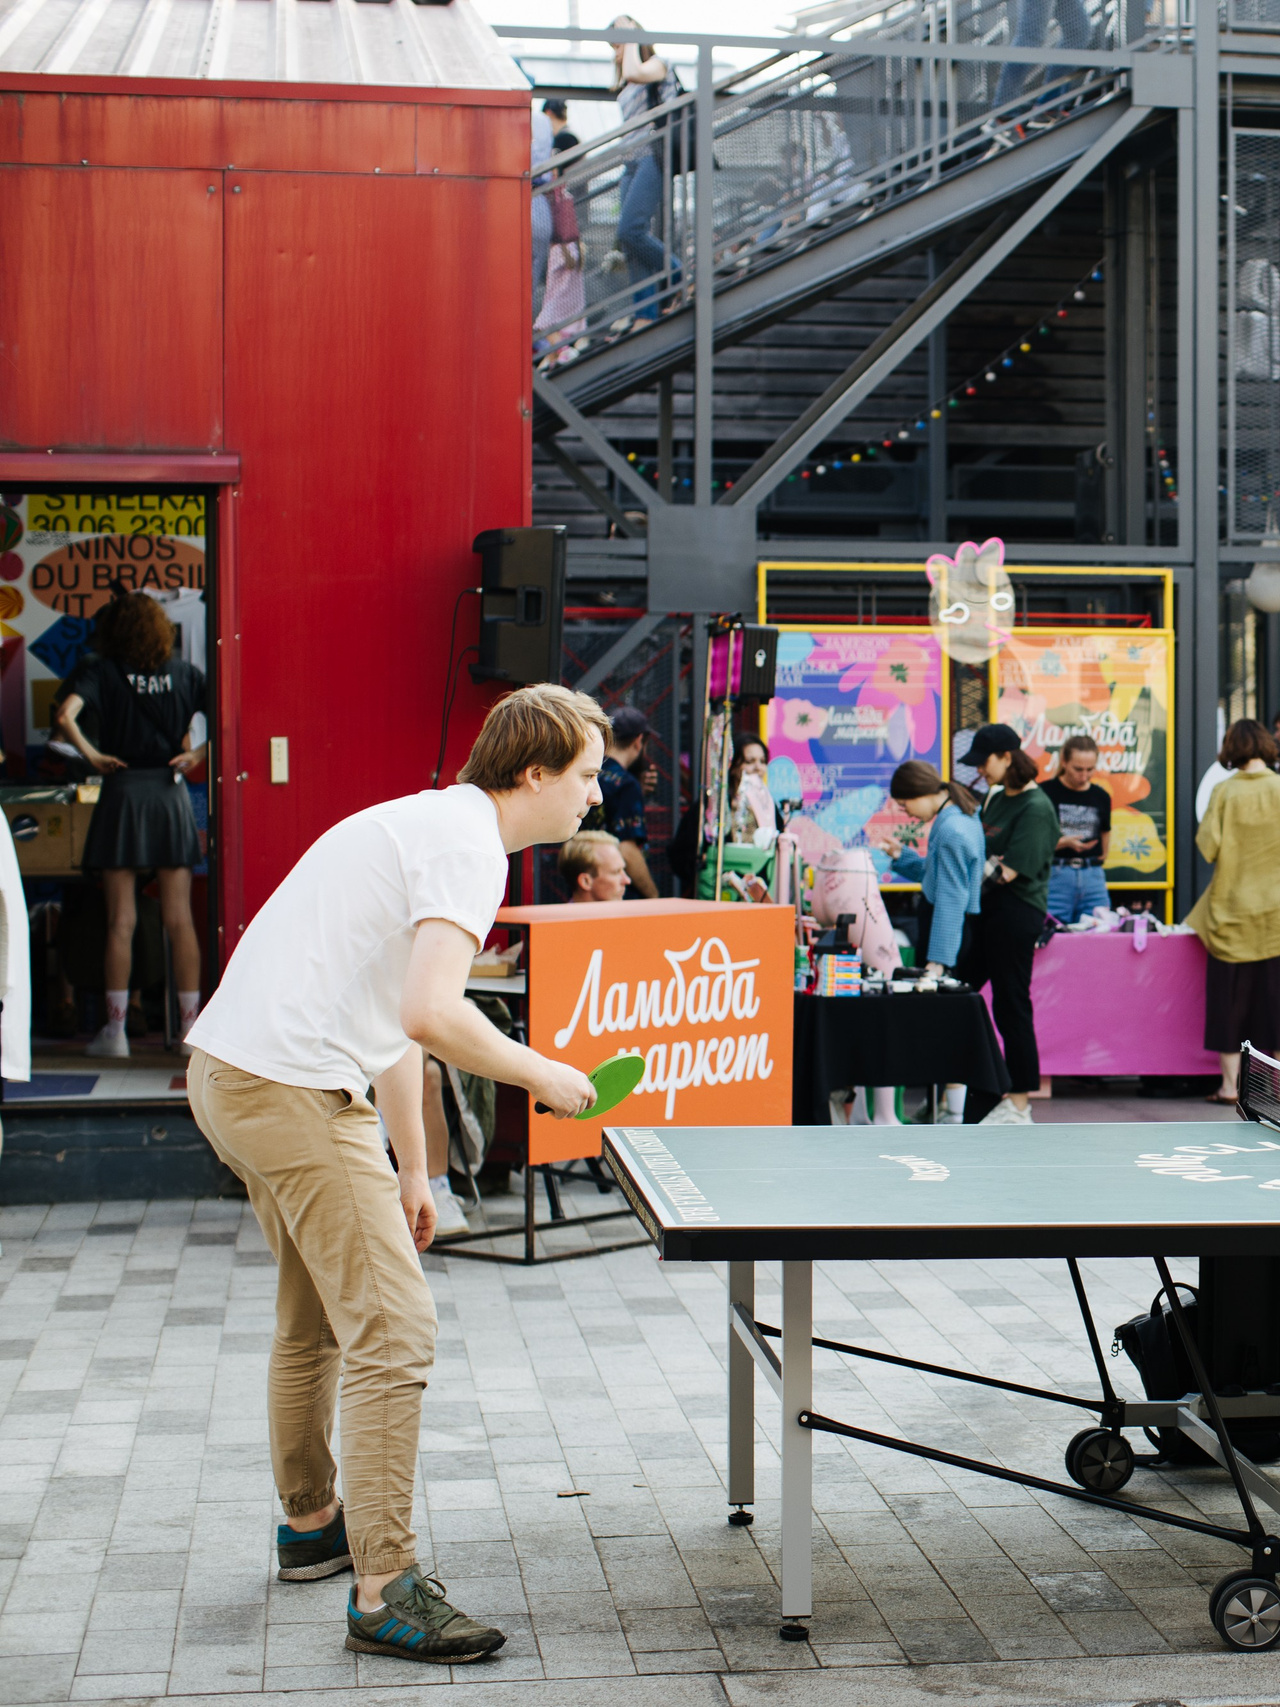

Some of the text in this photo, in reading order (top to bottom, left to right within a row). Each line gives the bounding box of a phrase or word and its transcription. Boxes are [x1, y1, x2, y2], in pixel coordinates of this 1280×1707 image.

[45, 495, 203, 511] STRELKA
[32, 563, 206, 590] DU BRASIL
[824, 636, 890, 650] JAMESON
[838, 649, 877, 663] YARD
[127, 673, 172, 694] TEAM
[554, 937, 760, 1049] Ламбада
[1134, 1153, 1255, 1183] PONG
[676, 1206, 720, 1222] BAR
